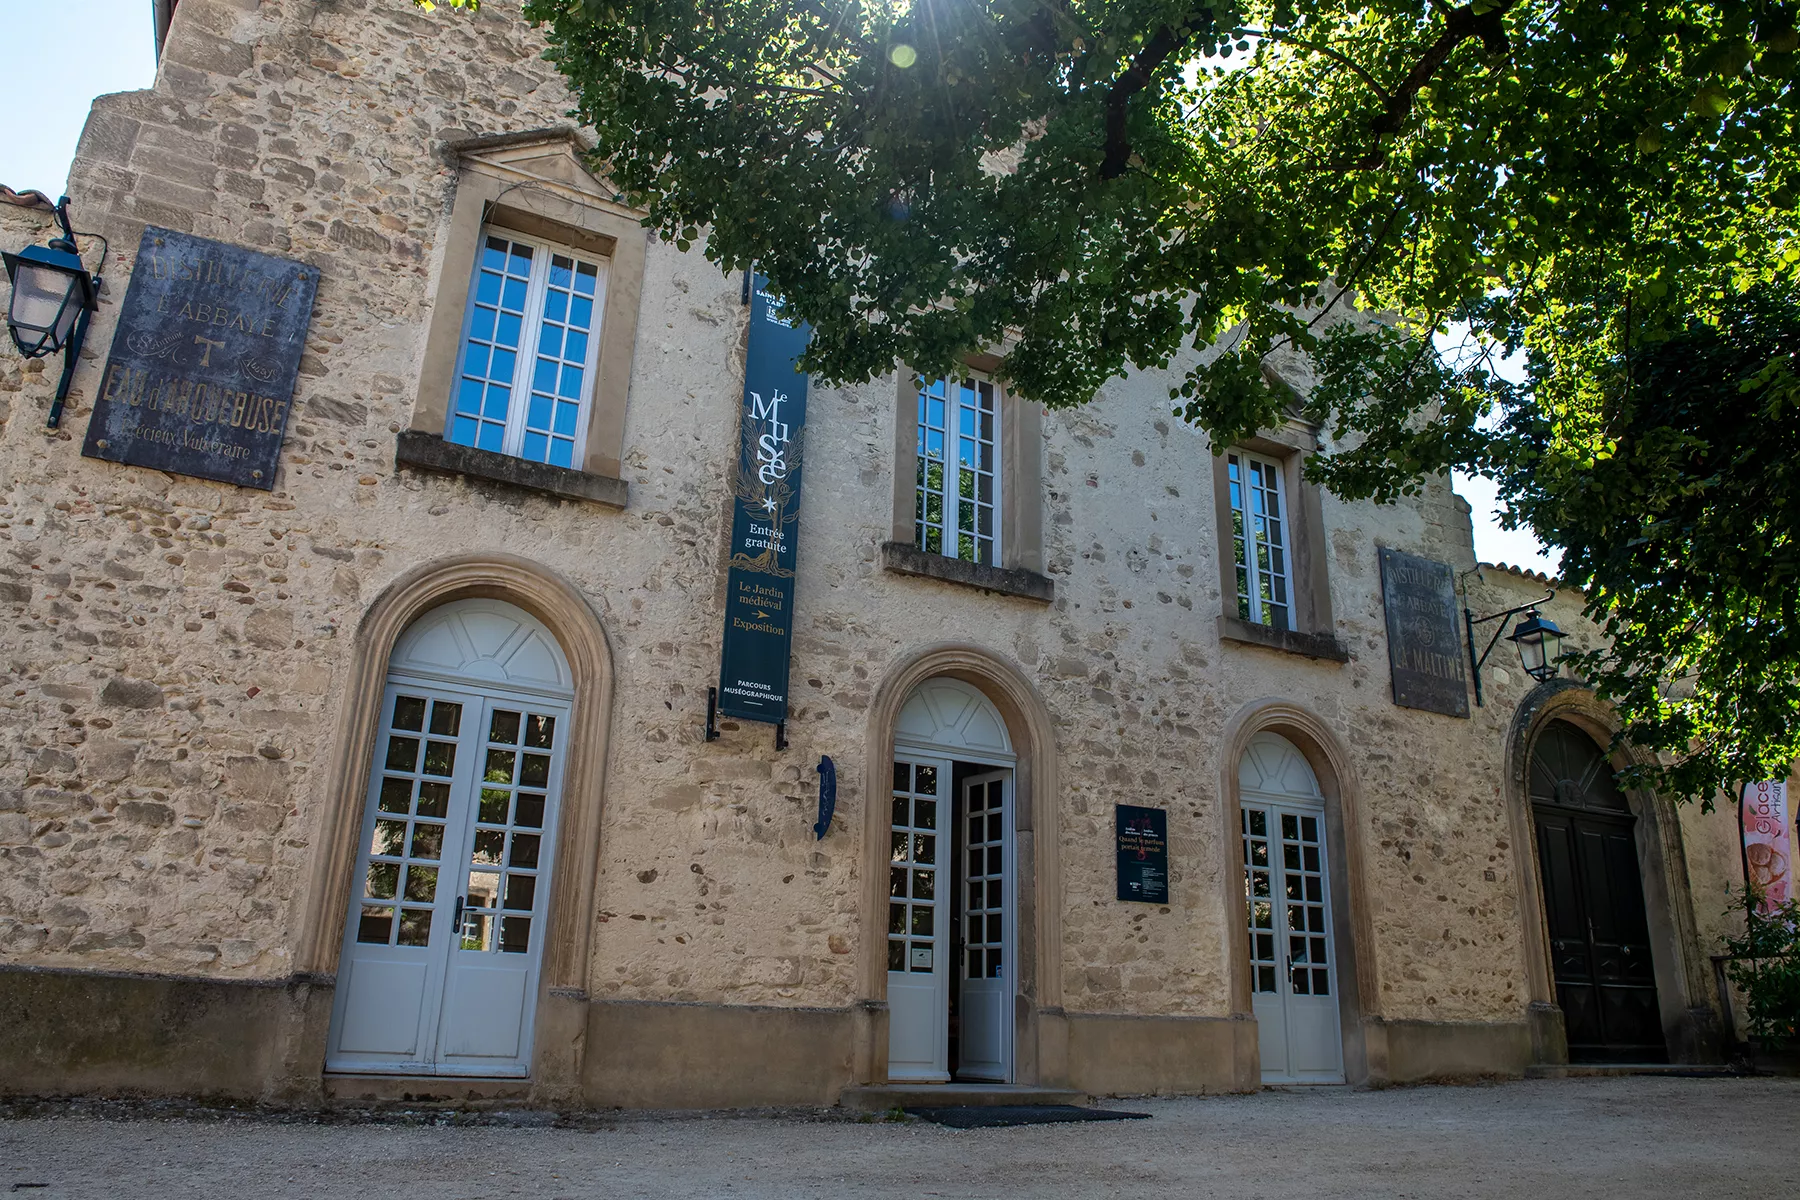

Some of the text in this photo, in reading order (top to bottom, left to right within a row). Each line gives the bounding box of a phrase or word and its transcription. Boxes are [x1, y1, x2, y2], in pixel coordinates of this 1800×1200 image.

[152, 254, 299, 311] DISTILLERIE
[102, 363, 150, 406] EAU
[749, 523, 785, 540] Entrée
[744, 537, 787, 553] gratuite
[739, 581, 784, 599] Le Jardin
[739, 595, 782, 611] médiéval
[733, 617, 785, 636] Exposition
[1413, 647, 1465, 682] MALTINE
[723, 687, 783, 702] MUSÉOGRAPHIQUE
[737, 680, 771, 691] PARCOURS
[1756, 781, 1771, 834] Glace
[1771, 781, 1782, 823] Artisan
